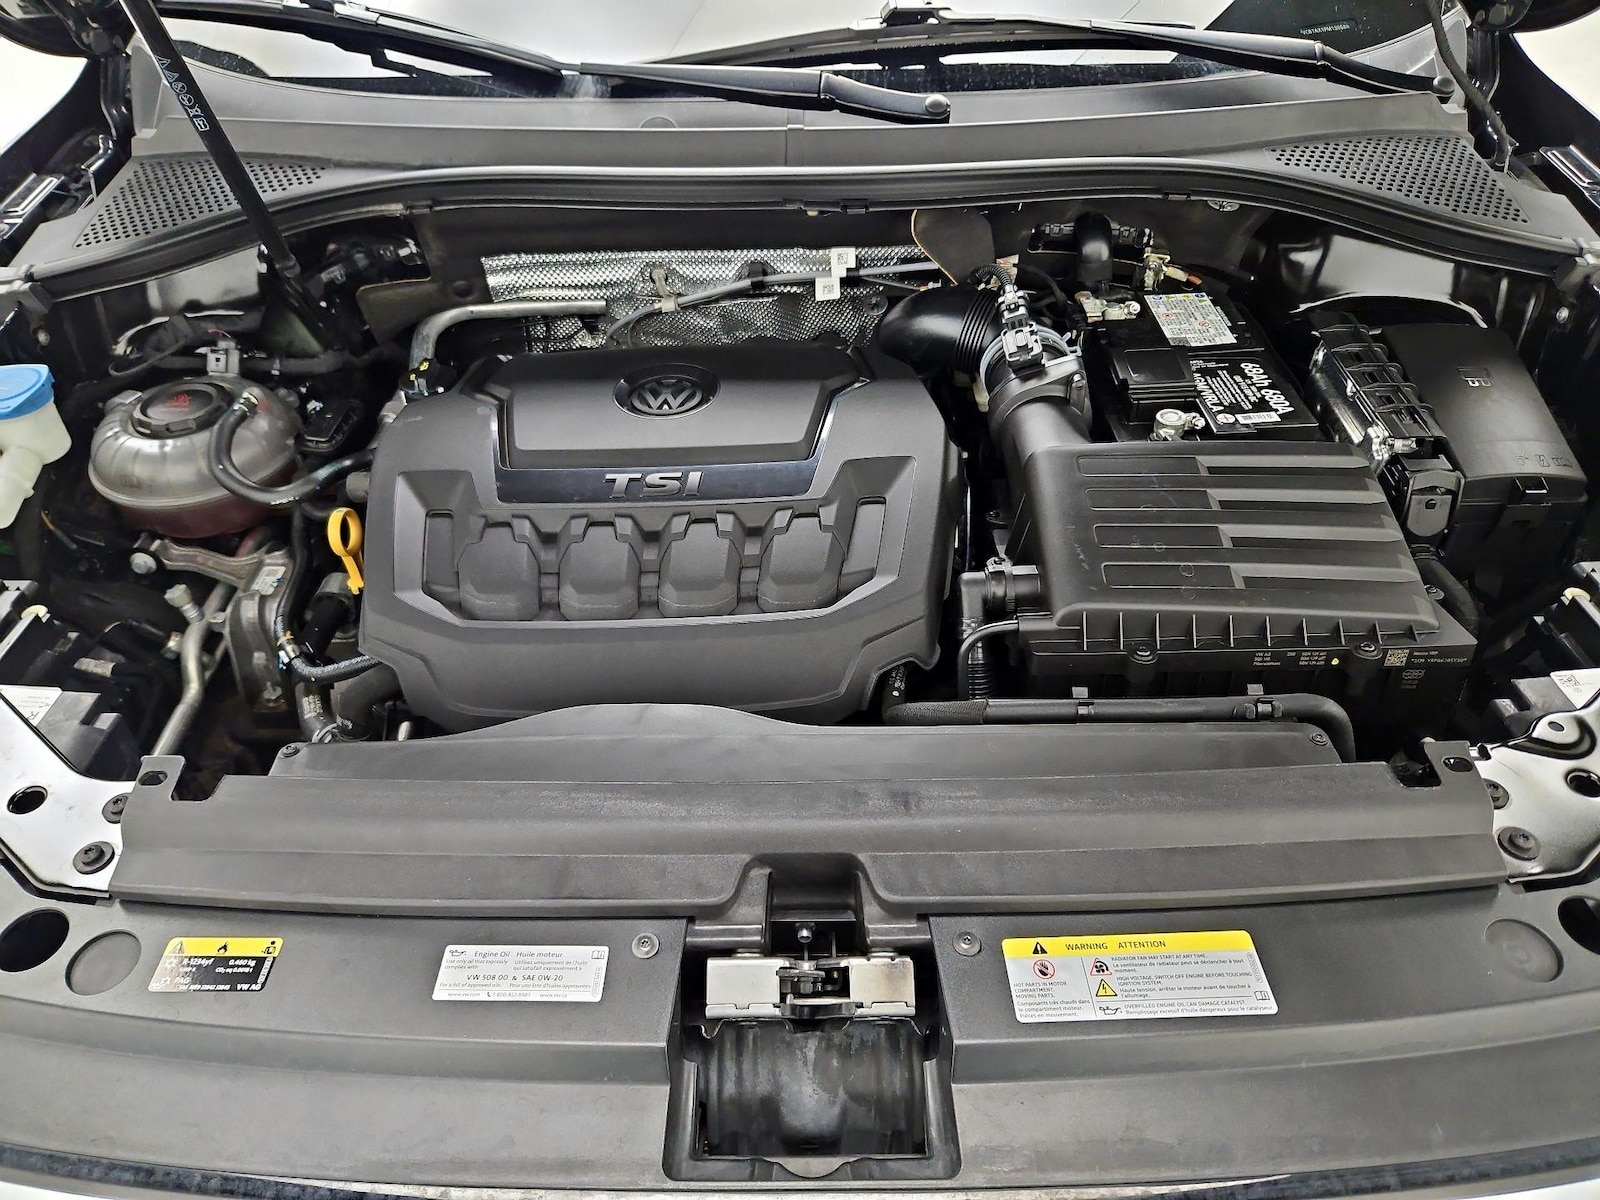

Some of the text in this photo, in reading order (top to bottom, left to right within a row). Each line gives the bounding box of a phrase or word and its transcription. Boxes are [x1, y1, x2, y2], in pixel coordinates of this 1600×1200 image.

[1240, 362, 1272, 387] 68Ah
[1260, 388, 1294, 414] 680A
[602, 472, 704, 498] TSI
[1065, 941, 1166, 950] WARNING ATTENTION
